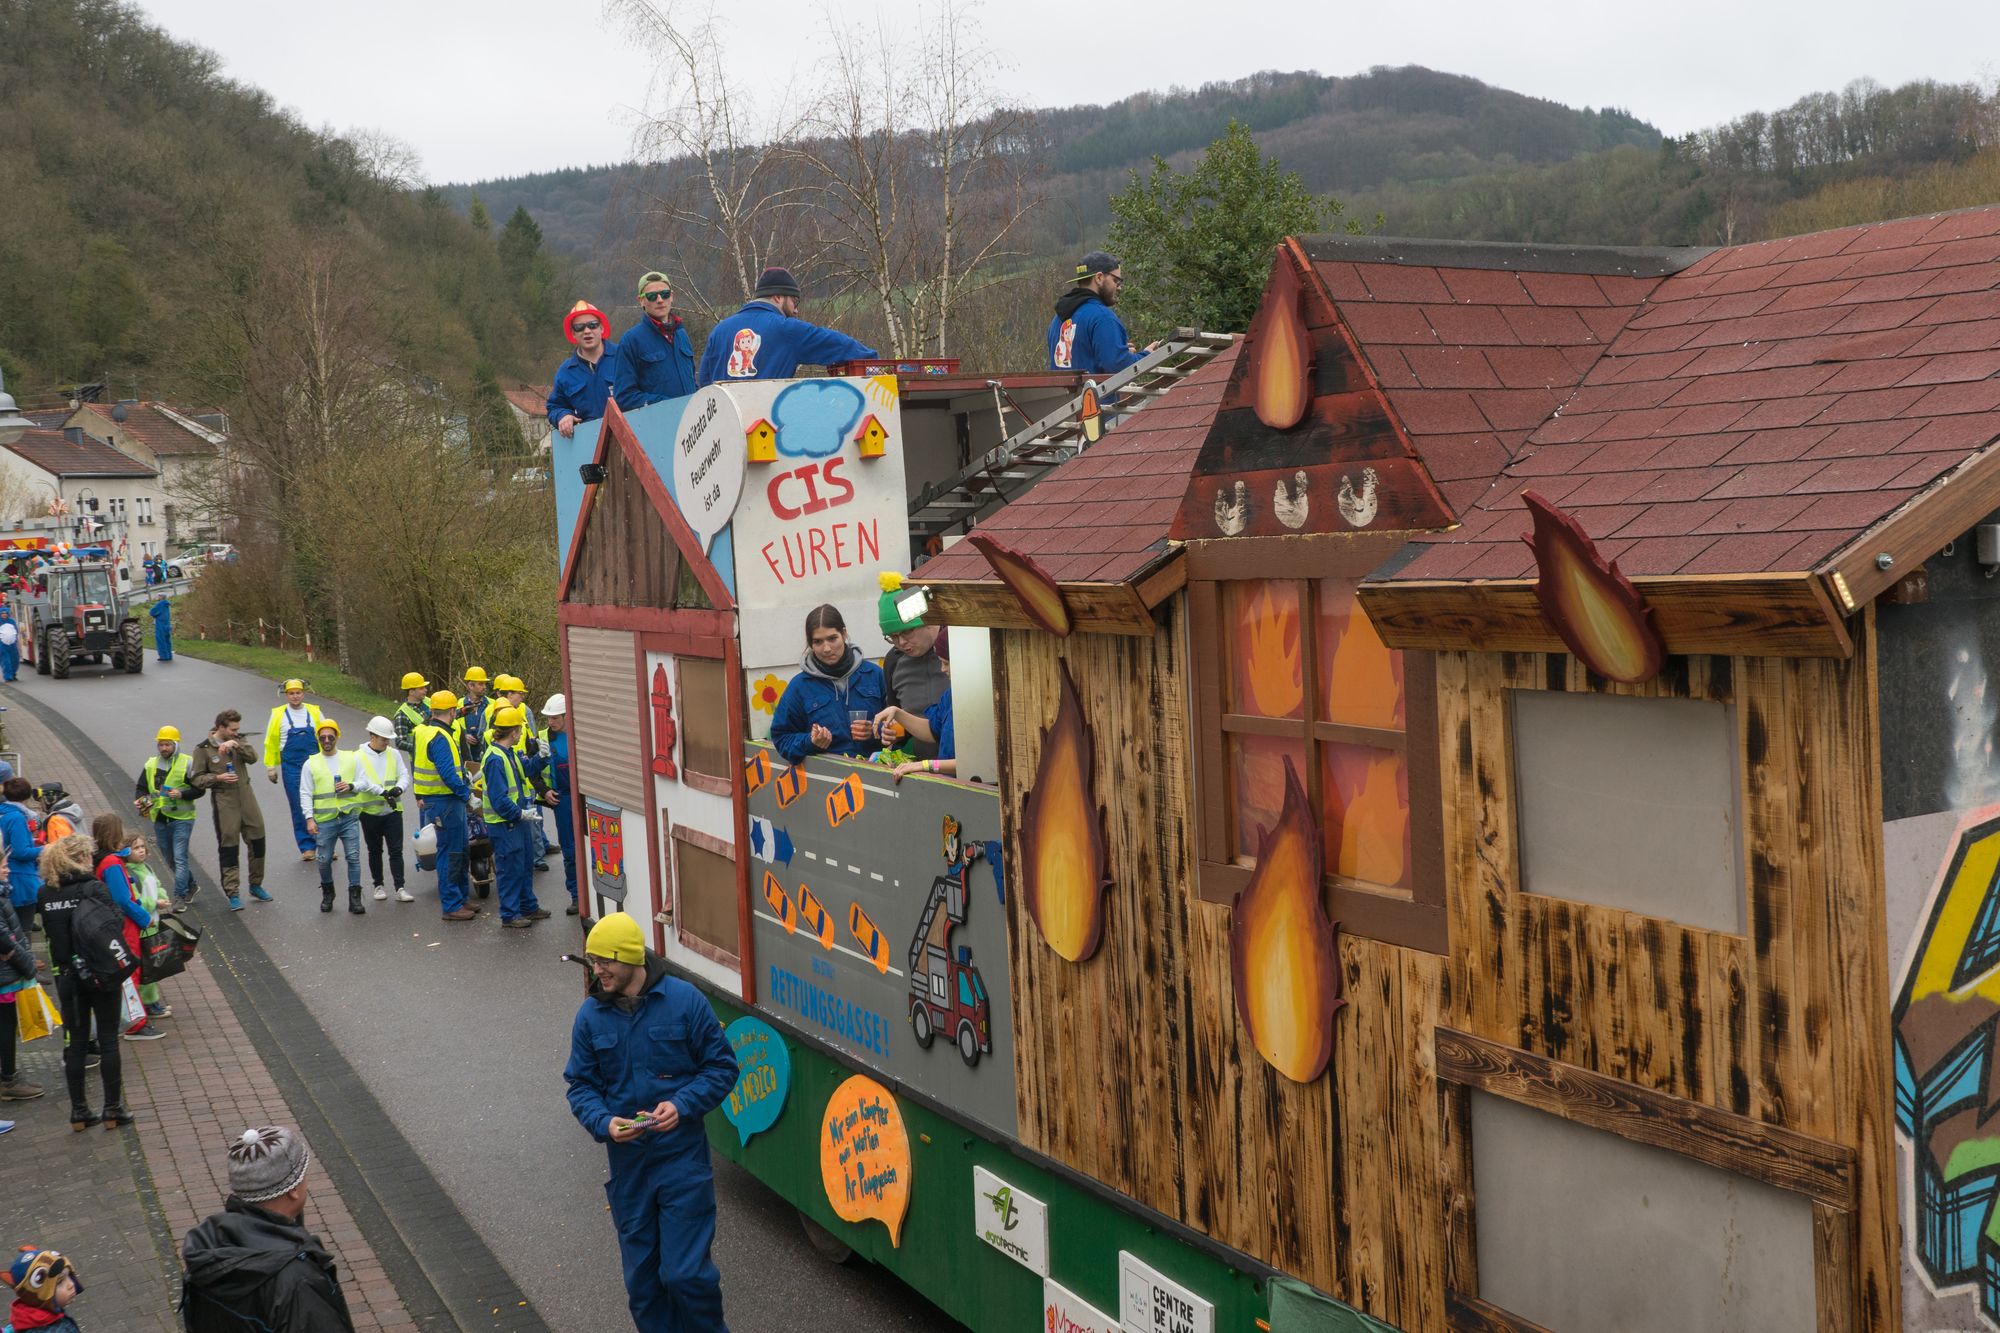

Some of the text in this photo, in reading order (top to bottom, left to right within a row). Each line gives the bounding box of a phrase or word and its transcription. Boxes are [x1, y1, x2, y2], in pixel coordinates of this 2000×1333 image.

[681, 397, 718, 457] Tatütata die
[690, 438, 721, 489] Feuerwehr
[703, 483, 721, 512] ist da
[767, 456, 855, 521] CIS
[761, 518, 879, 585] FUREN
[829, 1116, 844, 1148] Mir
[852, 1125, 880, 1156] Waffen
[1153, 1285, 1194, 1325] CENTRE
[1154, 1306, 1166, 1327] DE
